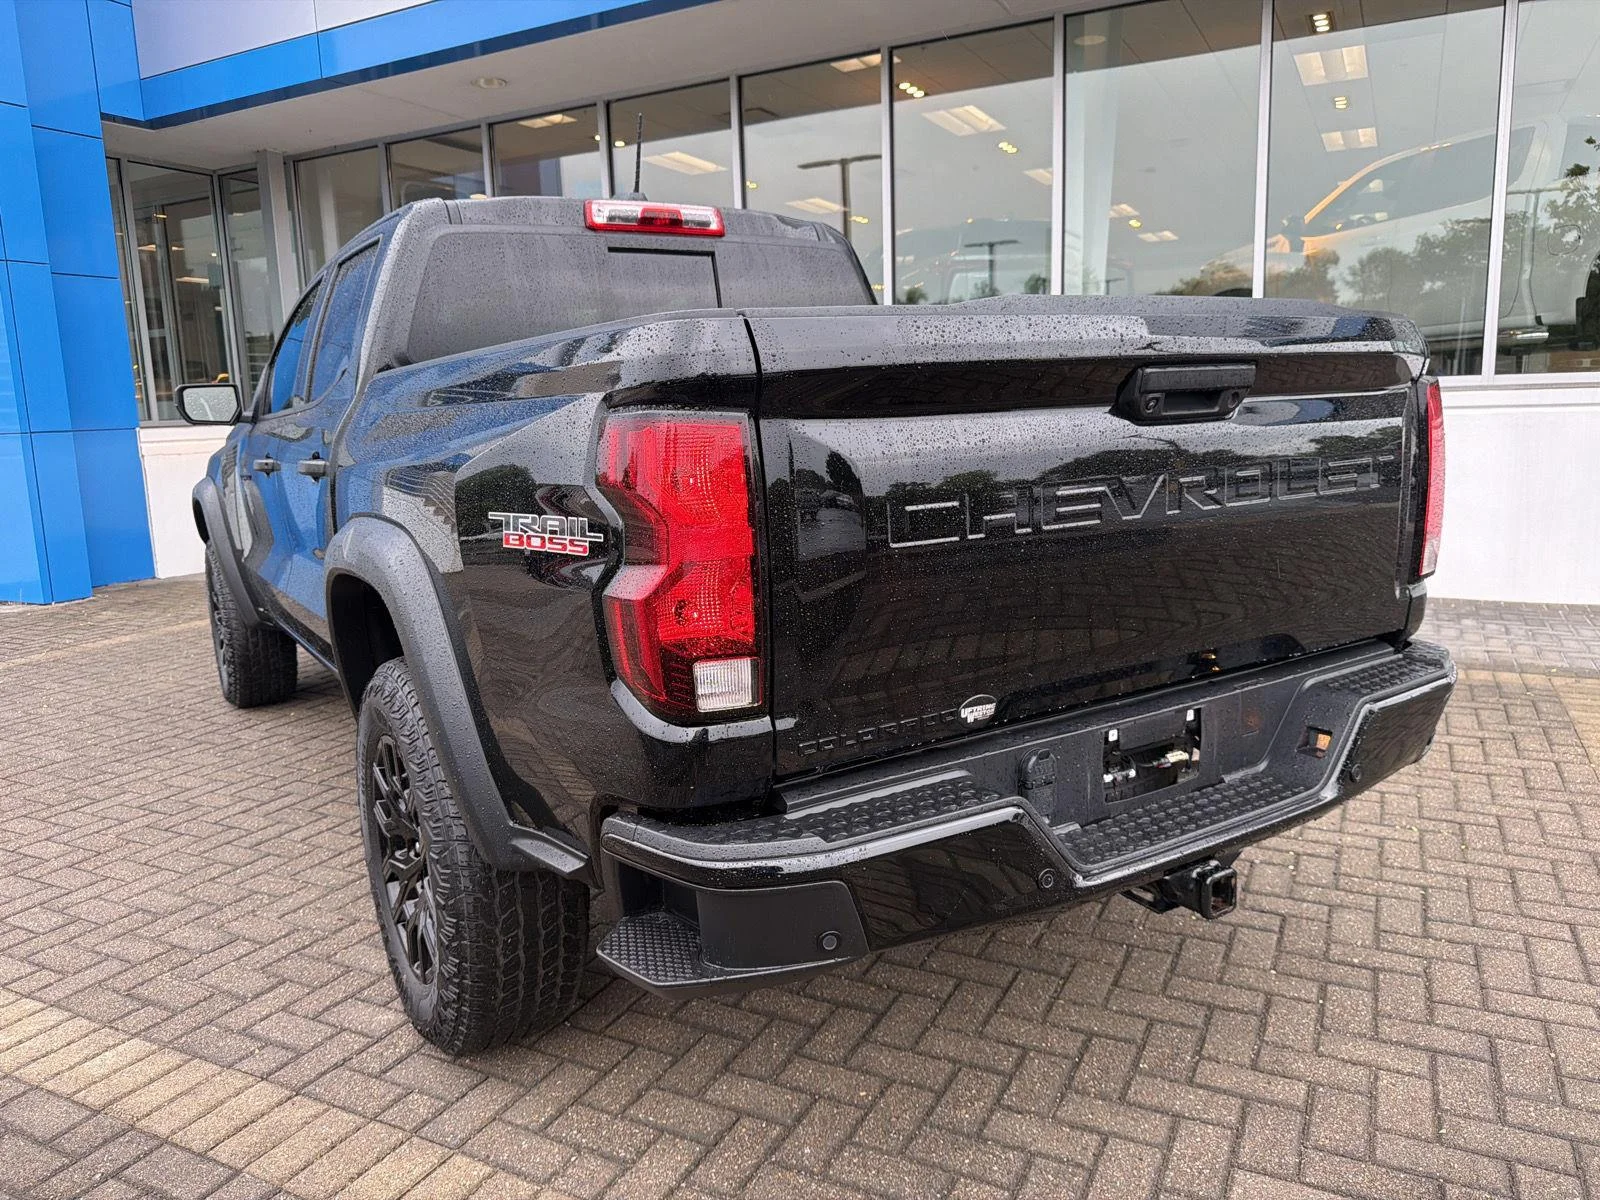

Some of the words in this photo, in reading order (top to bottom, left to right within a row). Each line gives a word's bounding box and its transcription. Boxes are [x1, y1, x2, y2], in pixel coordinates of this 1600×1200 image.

[888, 455, 1394, 548] CHEVROLET
[488, 512, 603, 541] TRAIL
[503, 532, 589, 556] BOSS
